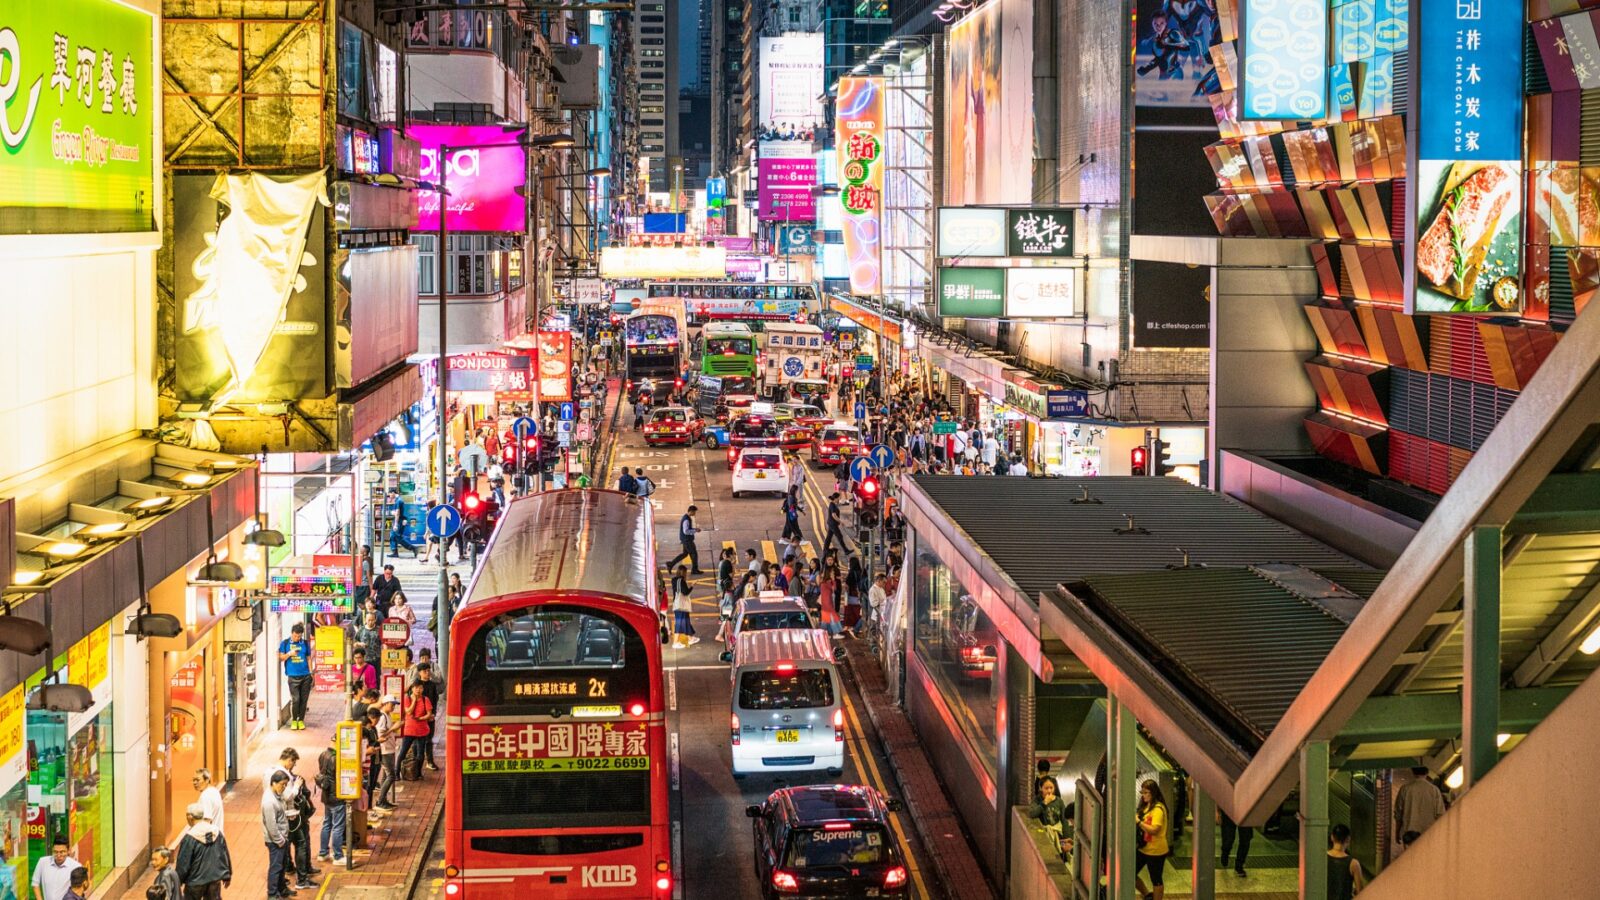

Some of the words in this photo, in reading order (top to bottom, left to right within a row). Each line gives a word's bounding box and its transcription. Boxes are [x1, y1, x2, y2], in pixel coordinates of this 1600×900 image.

[1455, 56, 1463, 115] CHARCOAL
[1465, 29, 1481, 151] 柞木炭家
[51, 118, 82, 164] Green
[1454, 121, 1462, 152] ROOM
[450, 358, 508, 371] BONJOUR
[312, 585, 332, 594] SPA
[465, 723, 648, 759] 56年中國牌專家
[576, 758, 610, 770] 9022
[614, 757, 647, 769] 6699
[812, 830, 863, 843] Supreme
[581, 864, 638, 889] KMB
